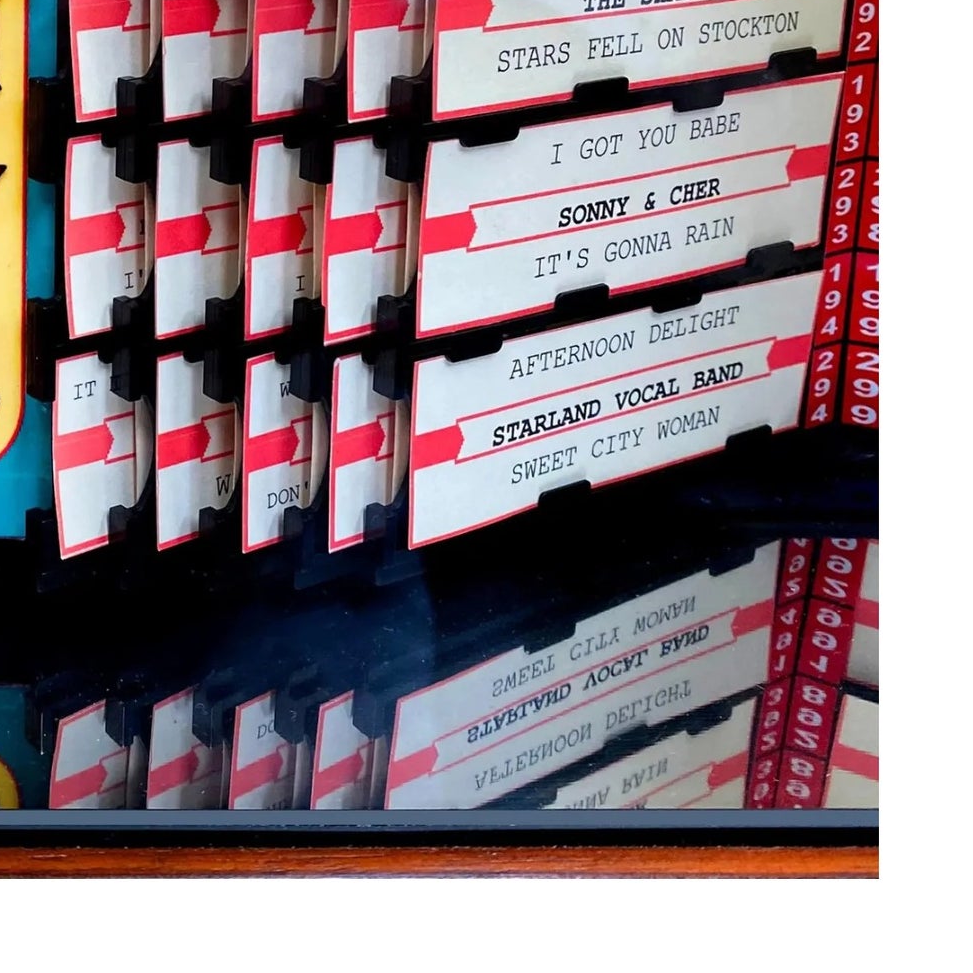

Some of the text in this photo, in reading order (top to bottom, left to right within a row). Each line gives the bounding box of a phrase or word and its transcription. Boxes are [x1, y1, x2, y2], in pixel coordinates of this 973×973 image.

[498, 11, 799, 72] STARS FELL ON STOCKTON
[551, 113, 740, 165] I GOT YOU BABE
[844, 76, 862, 151] 193
[559, 178, 720, 227] SONNY & CHER
[833, 169, 854, 242] 293
[535, 216, 734, 278] IT'S GONNA RAIN
[822, 264, 840, 334] 194
[509, 306, 739, 380] AFTERNOON DELIGHT
[492, 362, 743, 447] STARLAND VOCAL BAND
[812, 352, 833, 420] 294
[852, 352, 878, 423] 299
[512, 406, 720, 483] SWEET CITY WOMAN
